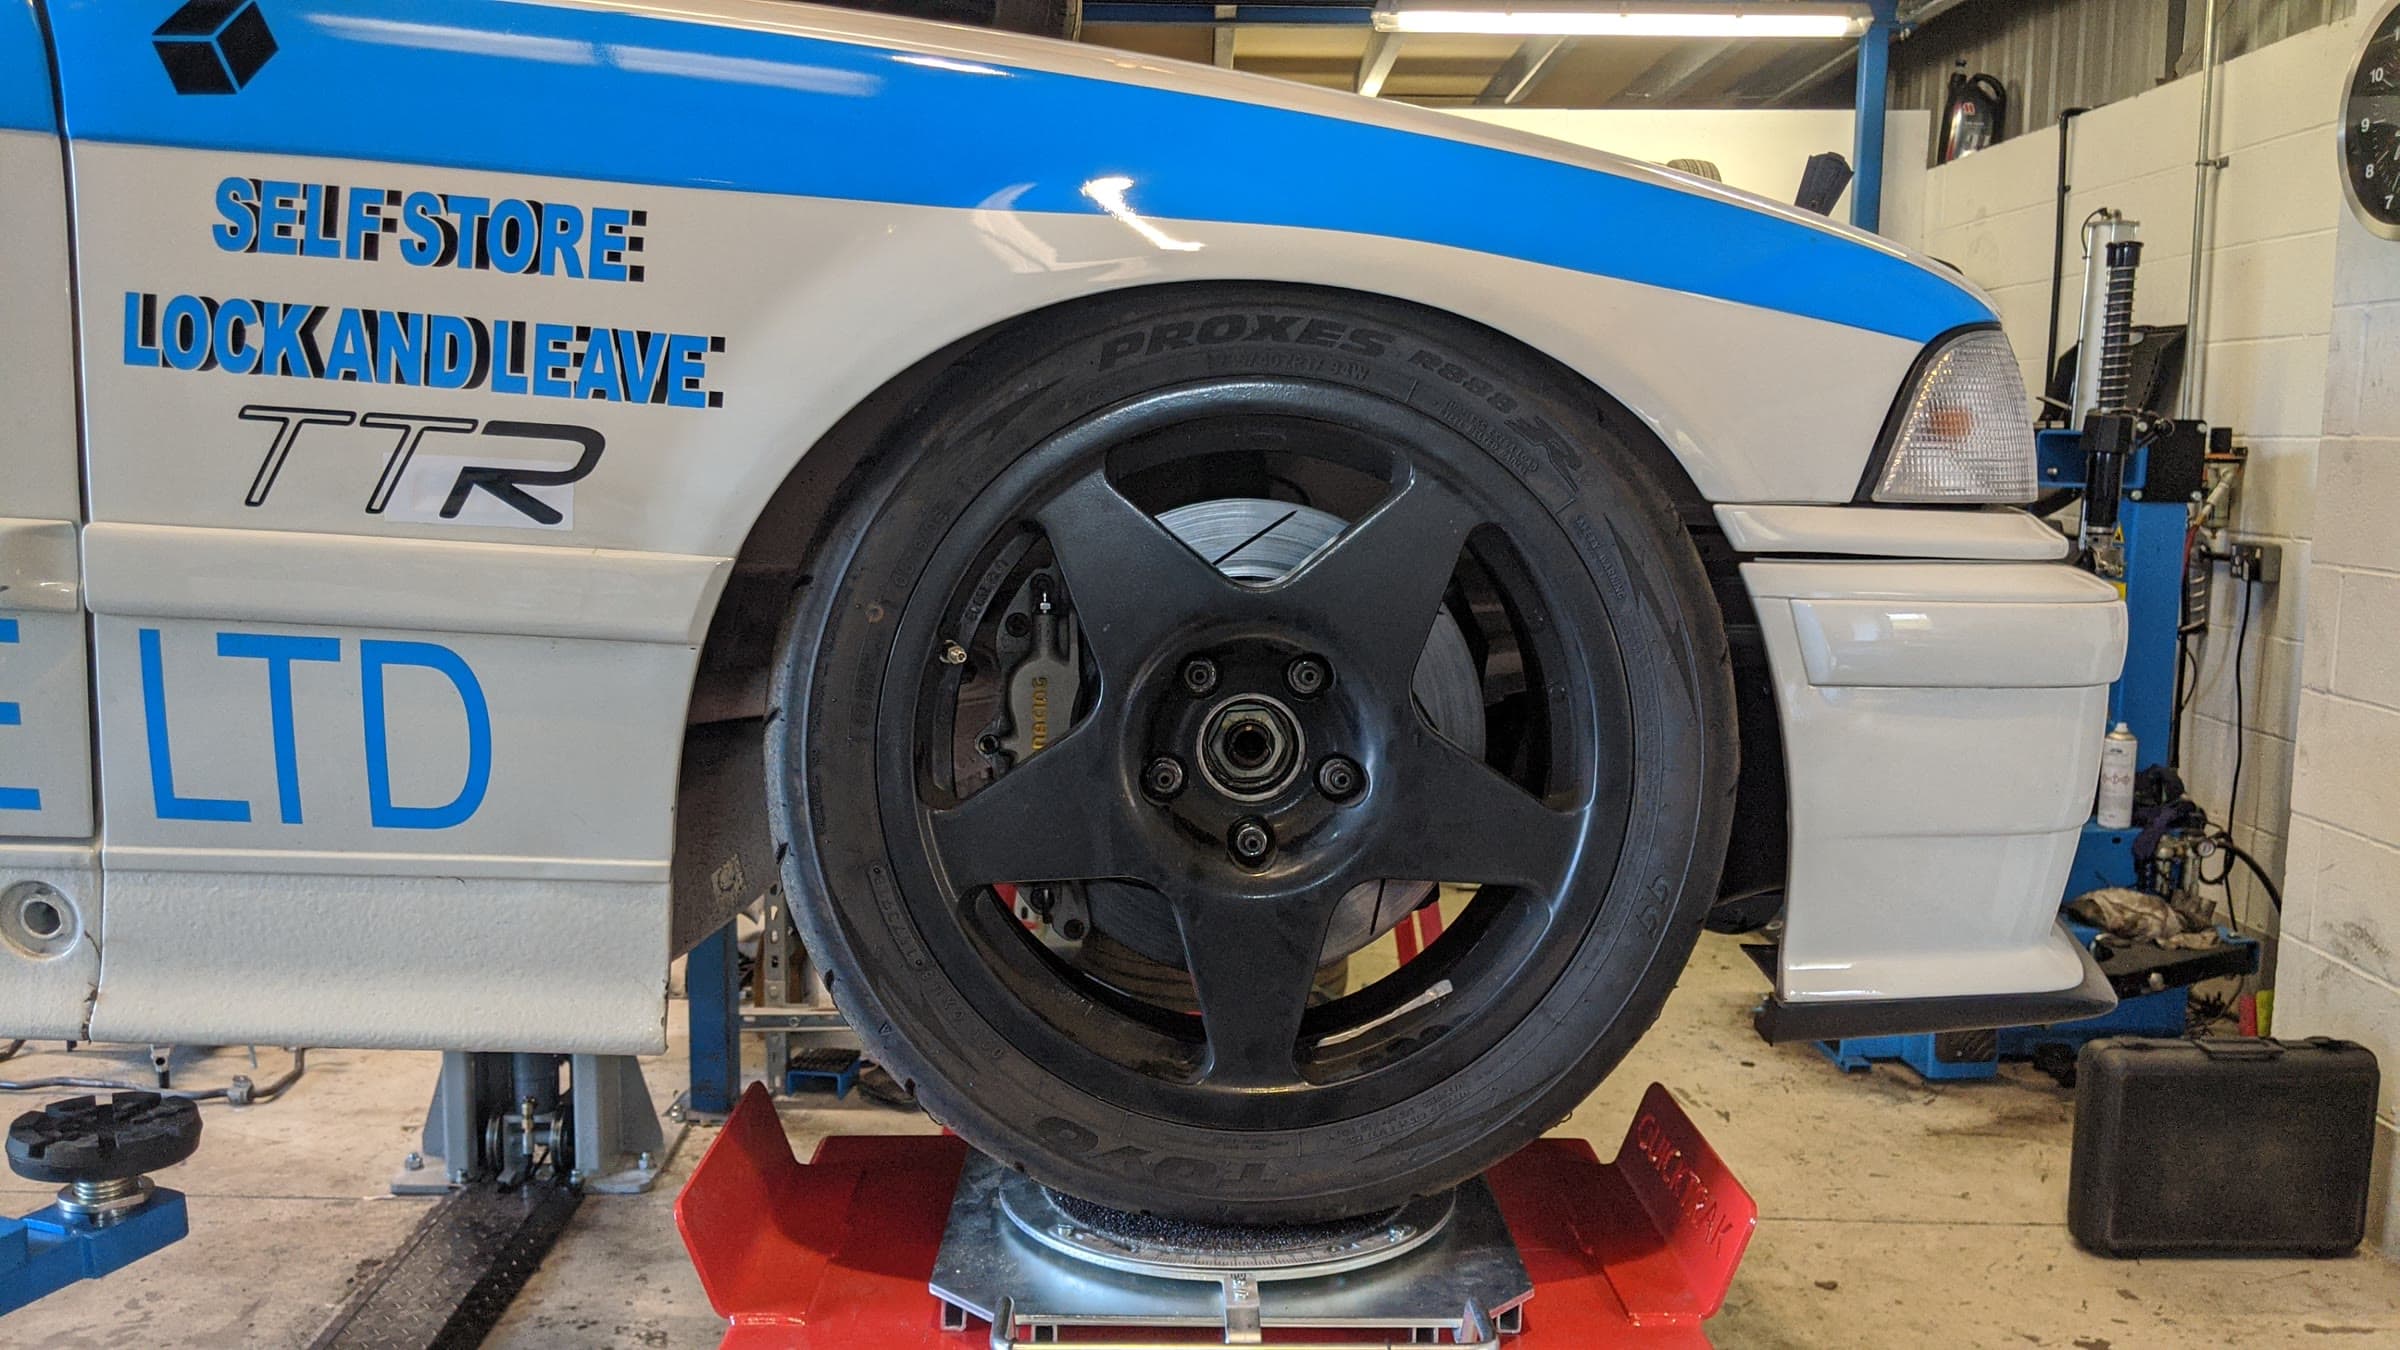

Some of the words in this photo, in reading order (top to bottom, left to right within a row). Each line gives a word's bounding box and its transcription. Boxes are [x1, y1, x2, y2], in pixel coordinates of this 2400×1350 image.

[2370, 66, 2384, 83] 10
[2361, 117, 2370, 133] 9
[2365, 163, 2375, 179] 8
[2384, 194, 2394, 211] 7
[1099, 313, 1395, 372] PROXES
[238, 404, 606, 525] TTR
[138, 628, 493, 830] LTD
[1034, 1114, 1281, 1193] TOYO
